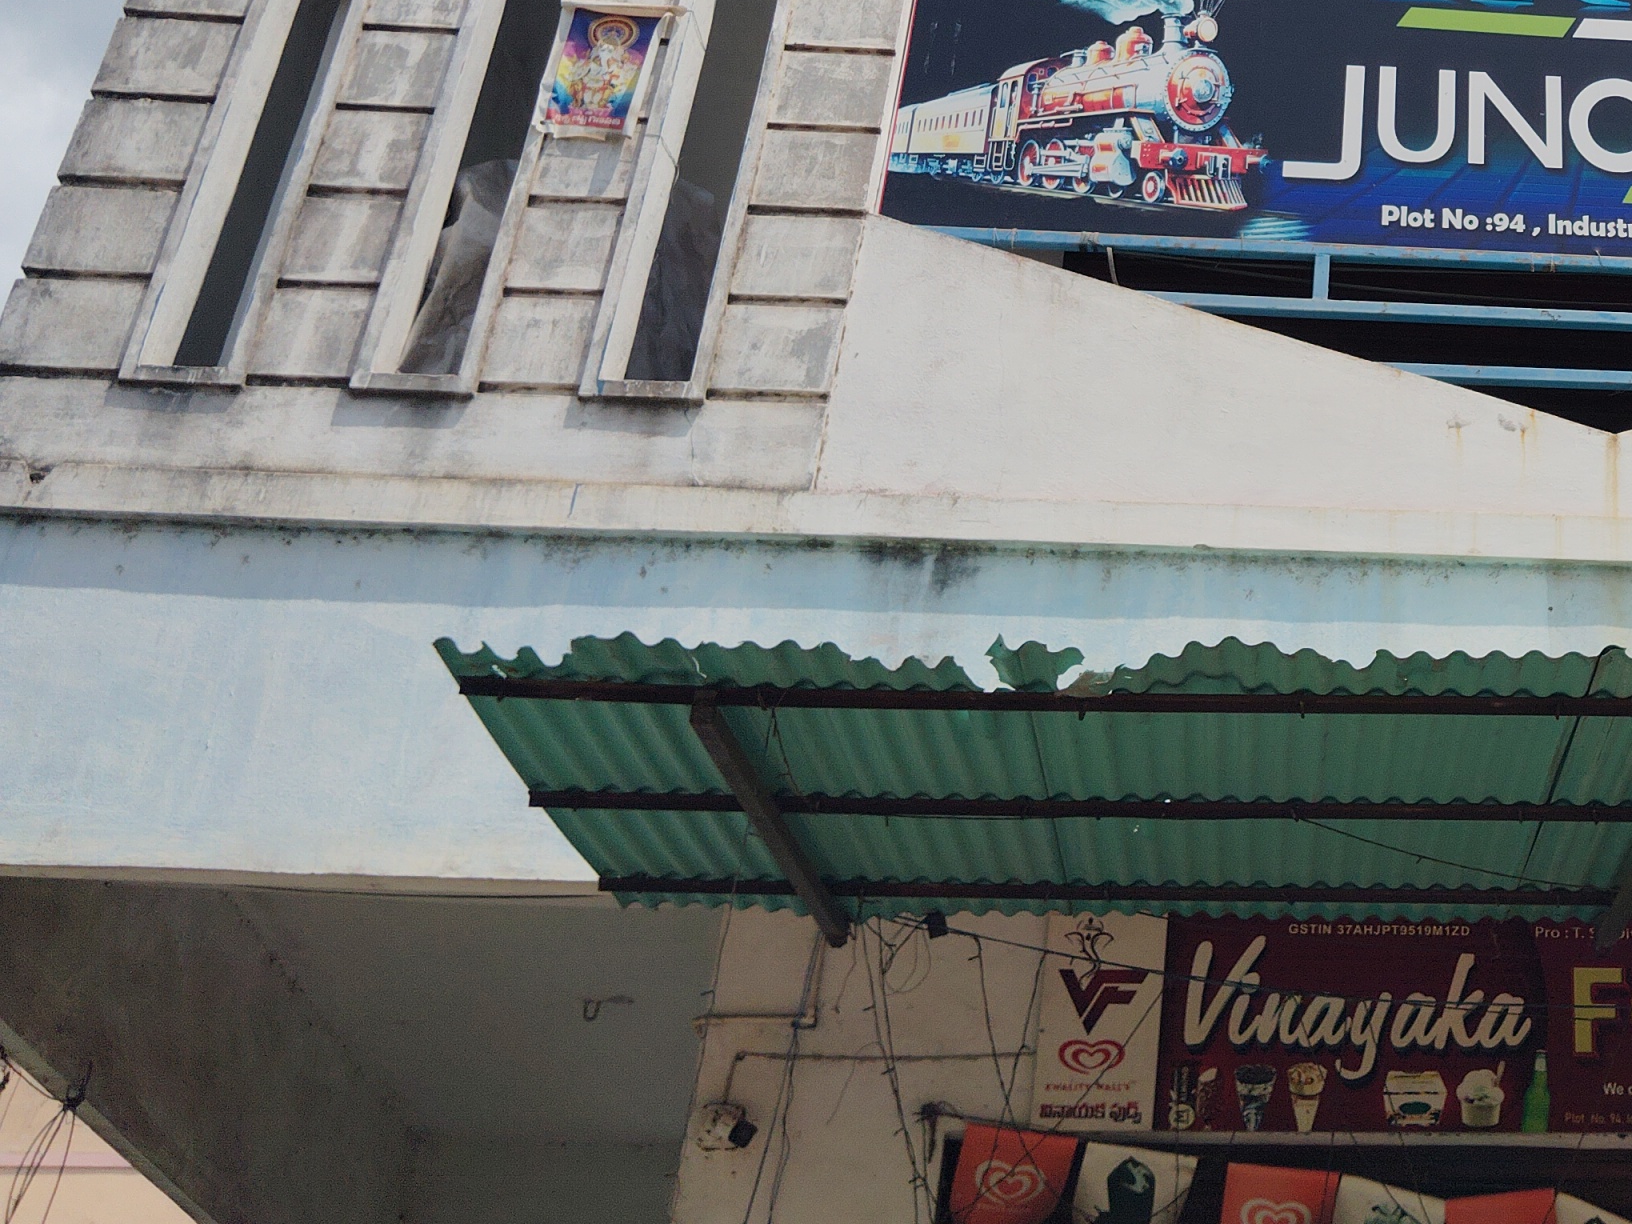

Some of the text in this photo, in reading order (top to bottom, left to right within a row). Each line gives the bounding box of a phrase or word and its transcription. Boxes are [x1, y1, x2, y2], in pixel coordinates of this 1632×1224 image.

[1381, 204, 1435, 229] Plot
[1288, 923, 1332, 935] GSTIN
[1184, 934, 1532, 1080] Vinayaka
[1603, 1082, 1625, 1097] We
